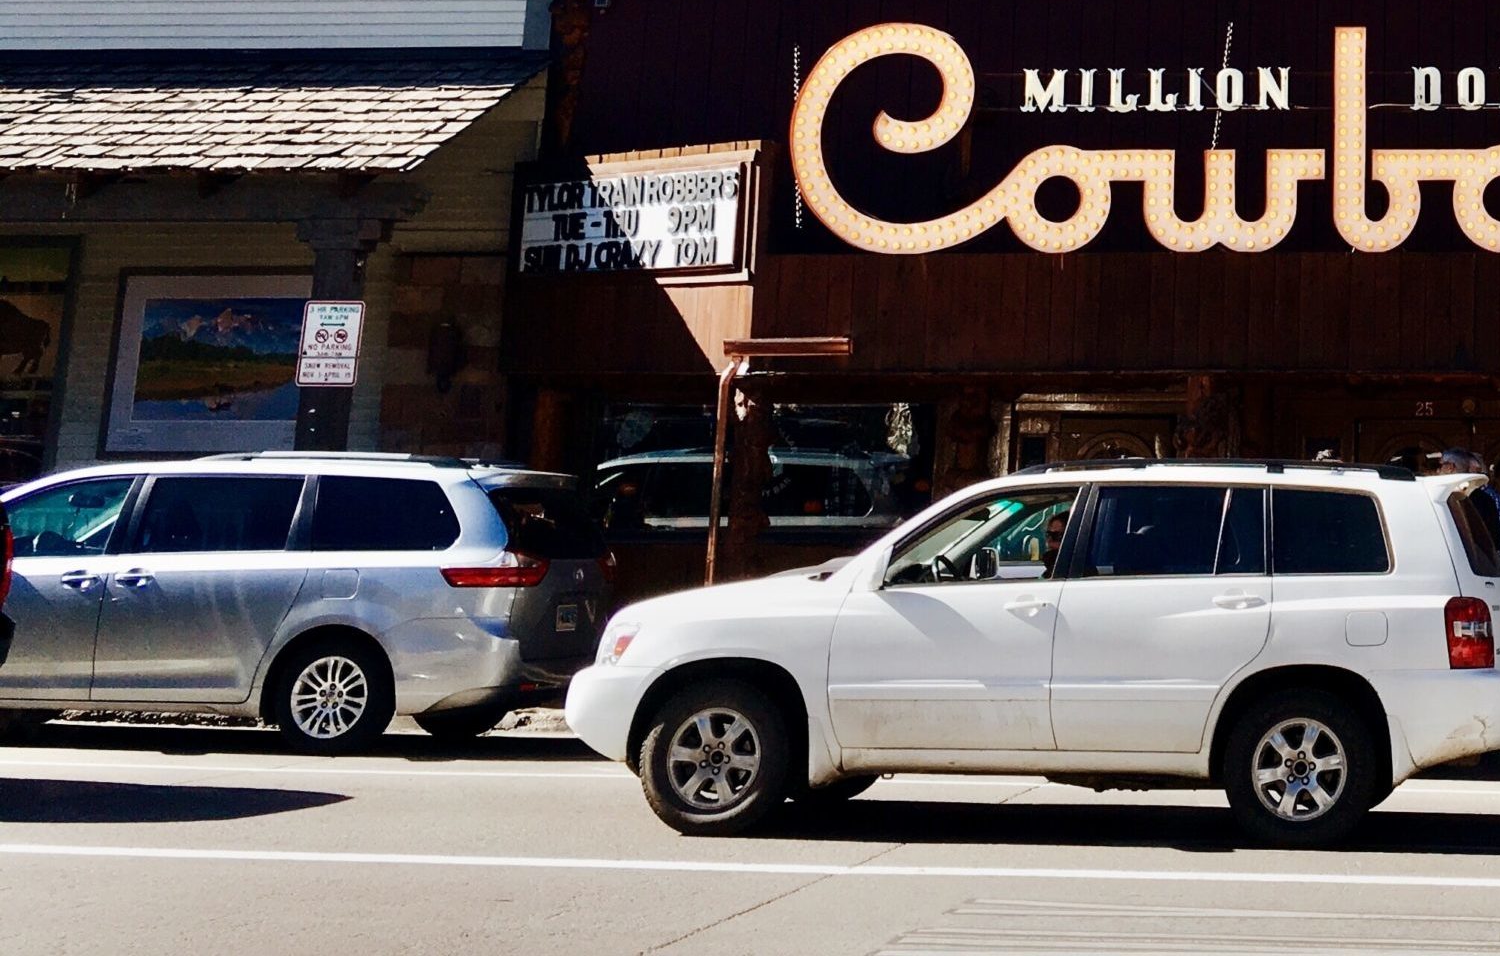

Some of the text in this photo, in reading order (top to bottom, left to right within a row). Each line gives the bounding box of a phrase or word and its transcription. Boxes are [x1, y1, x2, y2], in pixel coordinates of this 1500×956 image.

[1019, 67, 1291, 113] MILLION
[525, 170, 740, 214] TYLOR TRAIN ROBBERS
[552, 212, 587, 242] TUE
[667, 205, 716, 235] 9PM
[565, 243, 593, 269] DJ
[674, 236, 718, 266] TOM
[1415, 400, 1433, 417] 25
